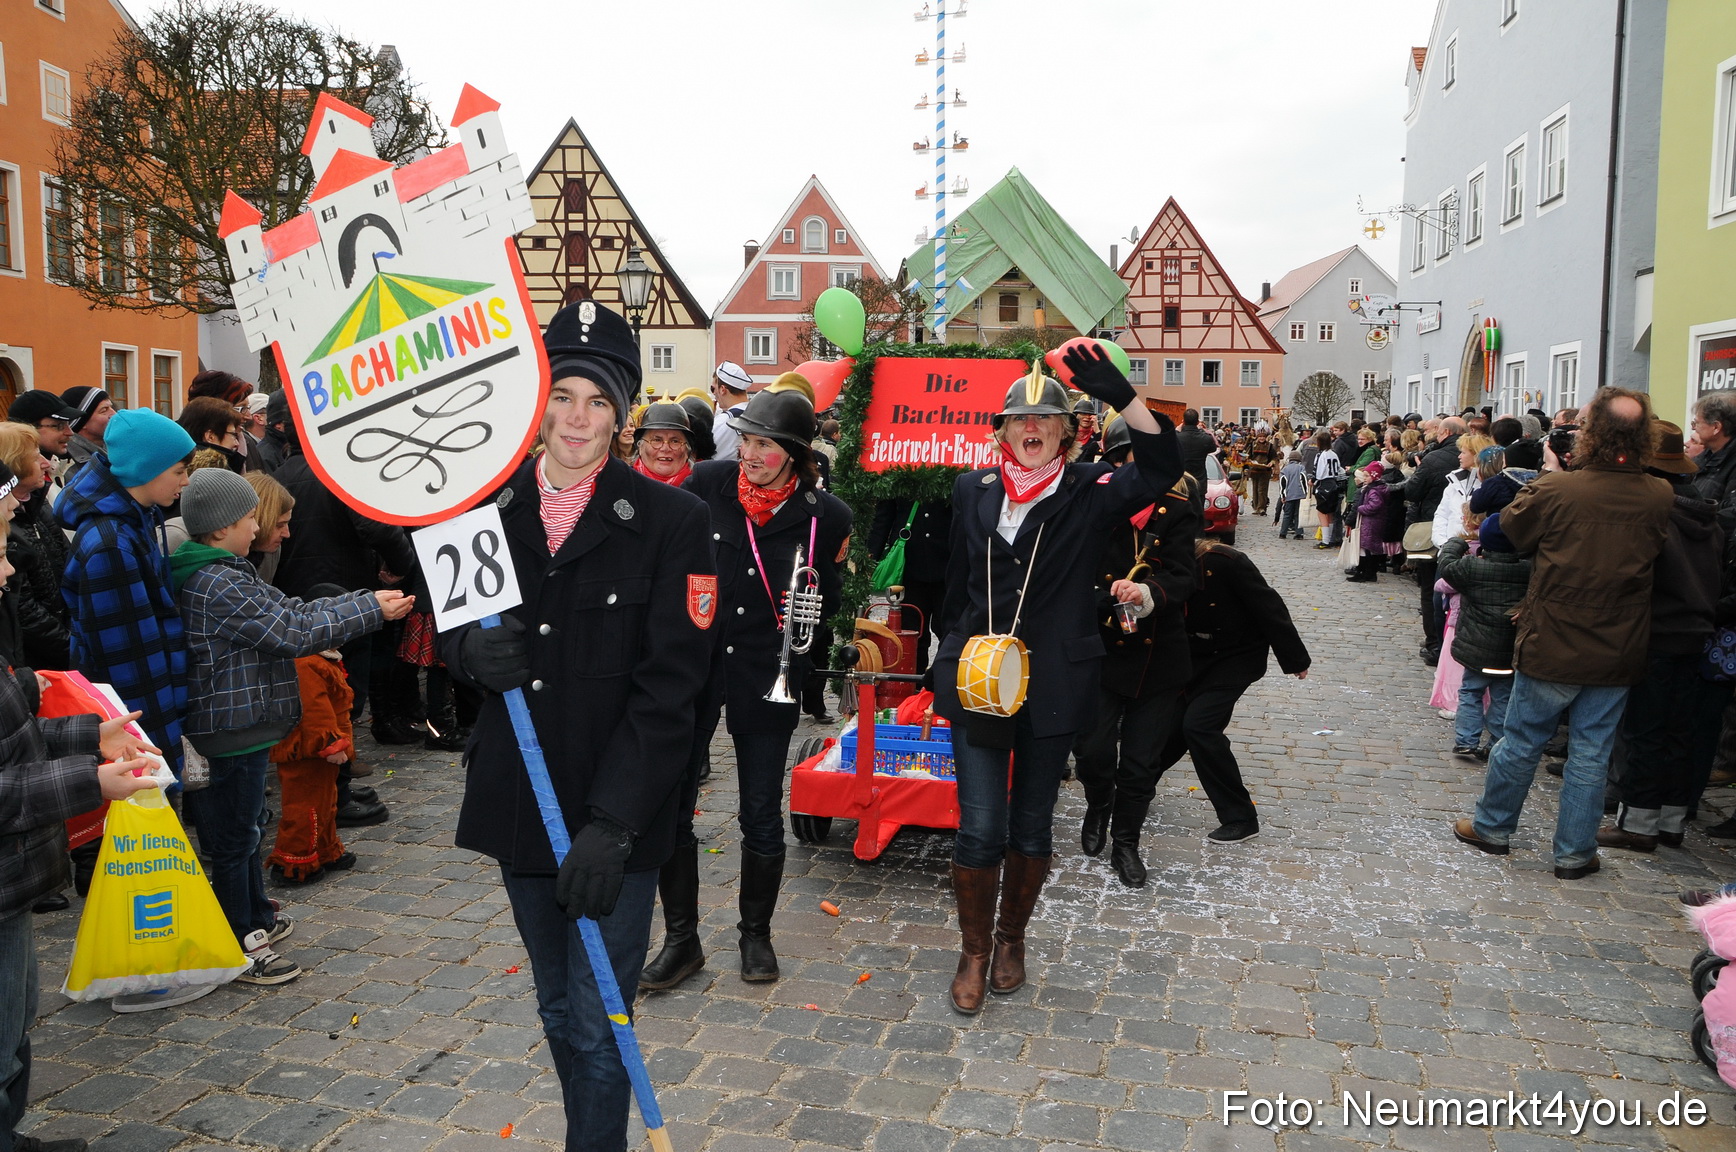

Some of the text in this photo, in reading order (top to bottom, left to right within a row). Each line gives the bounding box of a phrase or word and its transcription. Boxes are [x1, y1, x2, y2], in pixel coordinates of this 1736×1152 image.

[302, 296, 513, 416] BACHAMINIS
[923, 373, 968, 393] Die
[1701, 367, 1736, 390] HOF
[890, 404, 996, 425] Bacham
[1327, 458, 1339, 476] 10
[436, 529, 505, 614] 28
[113, 833, 186, 853] Wir lieben
[104, 854, 200, 876] ebensmittel.
[134, 928, 175, 940] EDEKA
